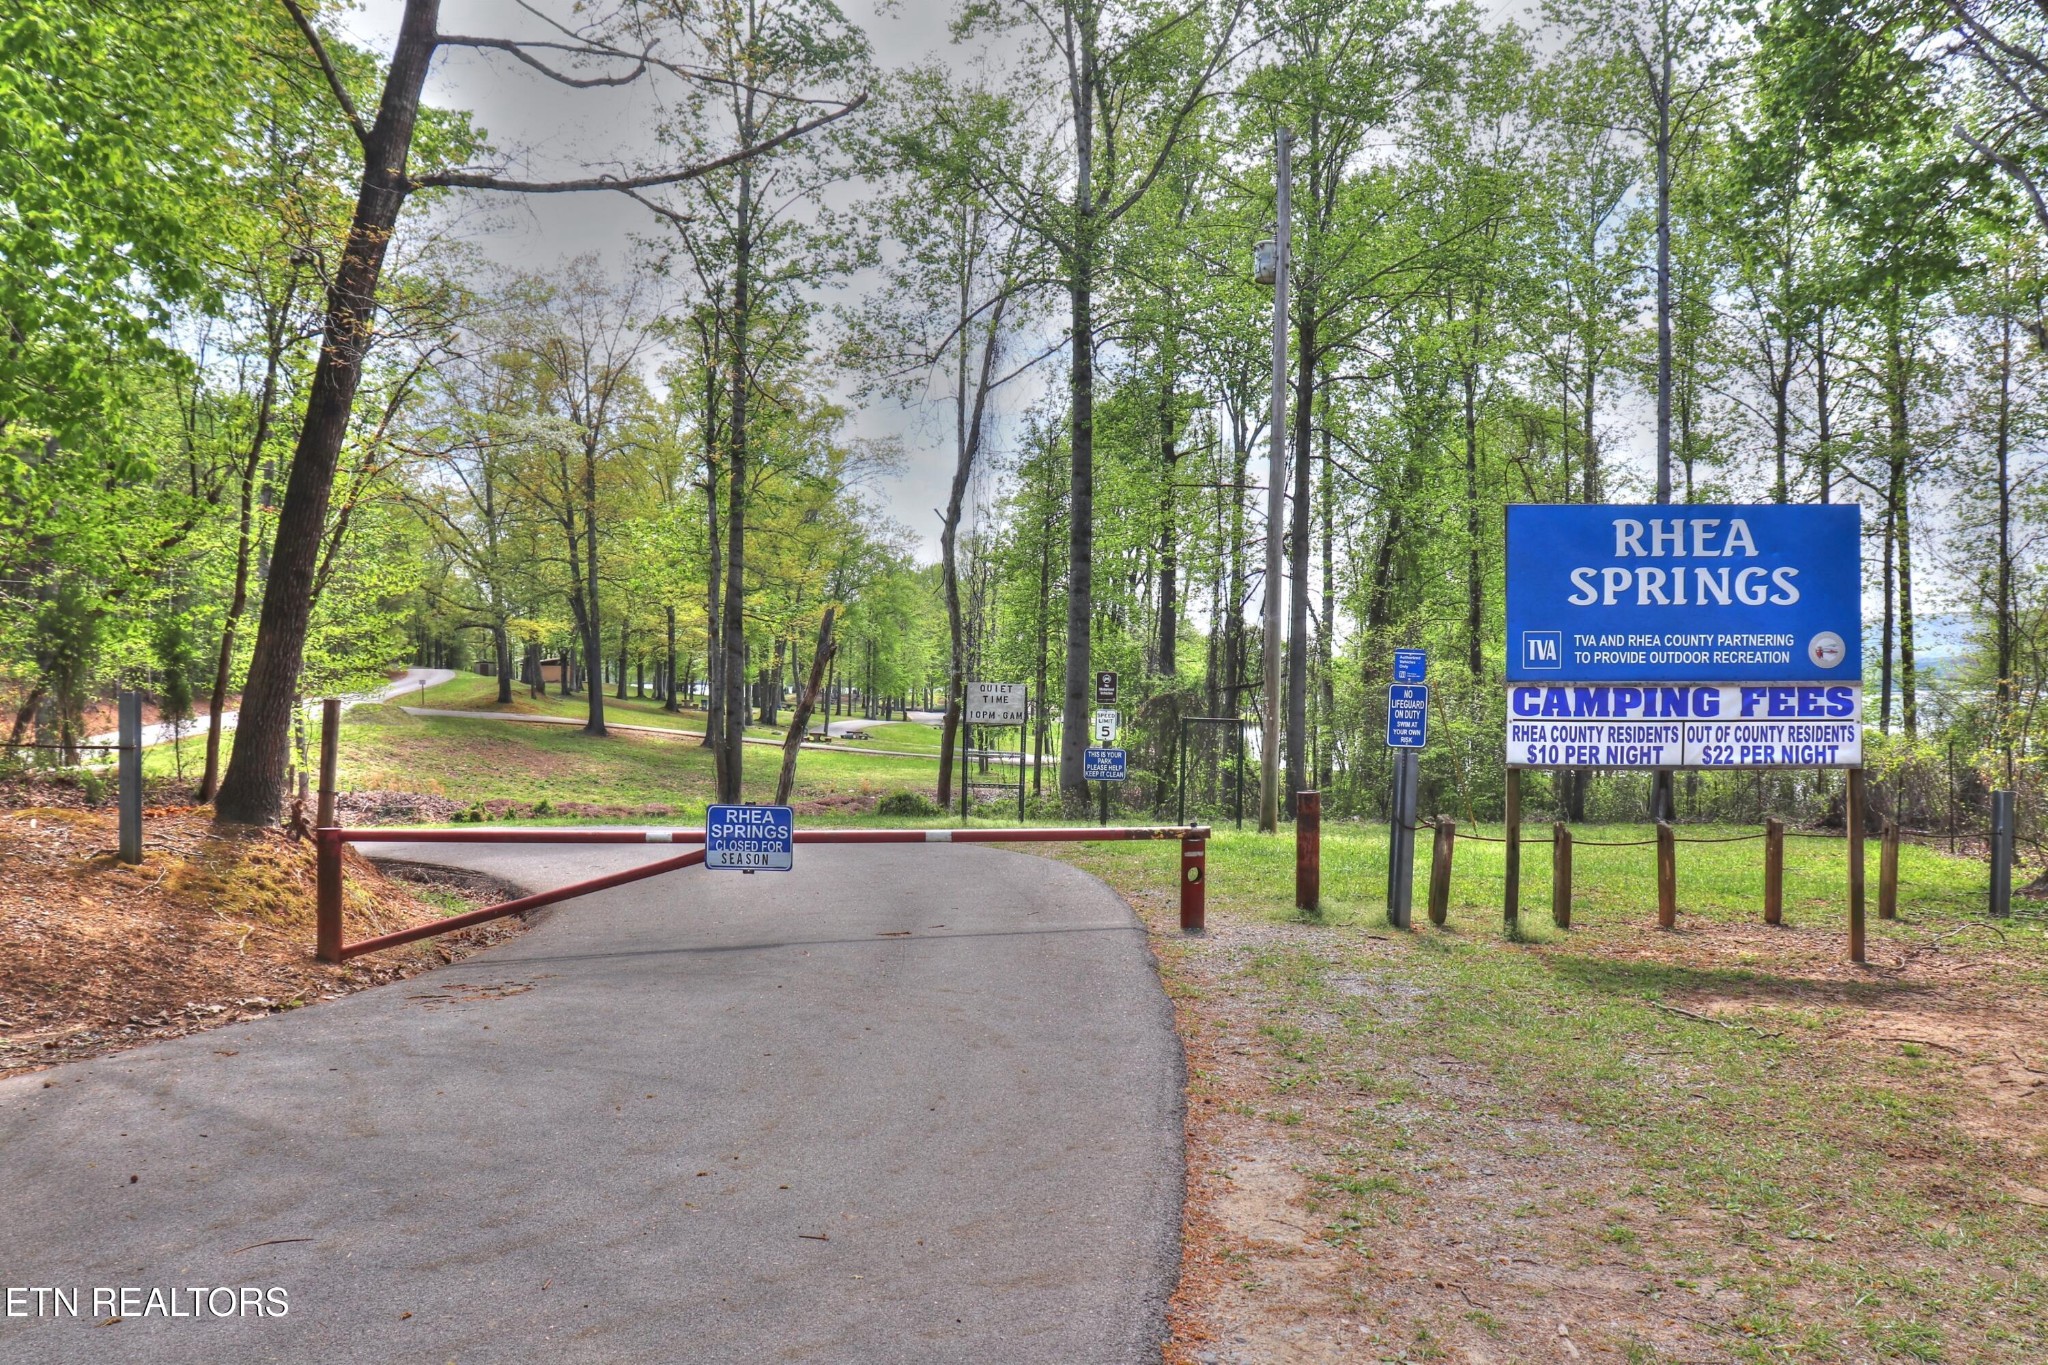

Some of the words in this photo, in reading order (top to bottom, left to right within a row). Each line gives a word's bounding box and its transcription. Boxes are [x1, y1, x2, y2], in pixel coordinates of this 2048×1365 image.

[1612, 519, 1759, 557] RHEA
[1568, 567, 1800, 606] SPRINGS
[1574, 634, 1596, 647] TVA
[1600, 634, 1625, 647] AND
[1628, 634, 1661, 647] RHEA
[1664, 634, 1713, 647] COUNTY
[1718, 634, 1794, 647] PARTNERING
[1528, 639, 1557, 661] TVA
[1574, 651, 1591, 664] TO
[1594, 651, 1646, 664] PROVIDE
[1649, 651, 1709, 664] OUTDOOR
[1713, 651, 1790, 664] RECREATION
[980, 684, 1013, 692] QUIET
[1404, 690, 1413, 698] NO
[1392, 700, 1424, 709] LIFEGUARD
[1512, 687, 1720, 717] CAMPING
[1740, 686, 1854, 717] FEES
[1395, 710, 1404, 718] ON
[1405, 710, 1421, 719] DUTY
[1102, 726, 1110, 737] 5
[1512, 725, 1547, 742] RHEA
[1551, 725, 1604, 743] COUNTY
[1608, 726, 1679, 743] RESIDENTS
[1687, 725, 1712, 743] OUT
[1715, 725, 1730, 743] OF
[1734, 725, 1784, 743] COUNTY
[1788, 725, 1854, 742] RESIDENTS
[1527, 744, 1559, 764] $10
[1565, 746, 1599, 764] PER
[1607, 746, 1664, 765] NIGHT
[1702, 745, 1733, 764] $22
[1741, 745, 1775, 764] PER
[1782, 745, 1839, 764] NIGHT
[726, 810, 774, 824] RHEA
[711, 825, 788, 839] SPRINGS
[716, 840, 758, 852] CLOSED
[762, 841, 783, 852] FOR
[722, 853, 769, 865] SEASON
